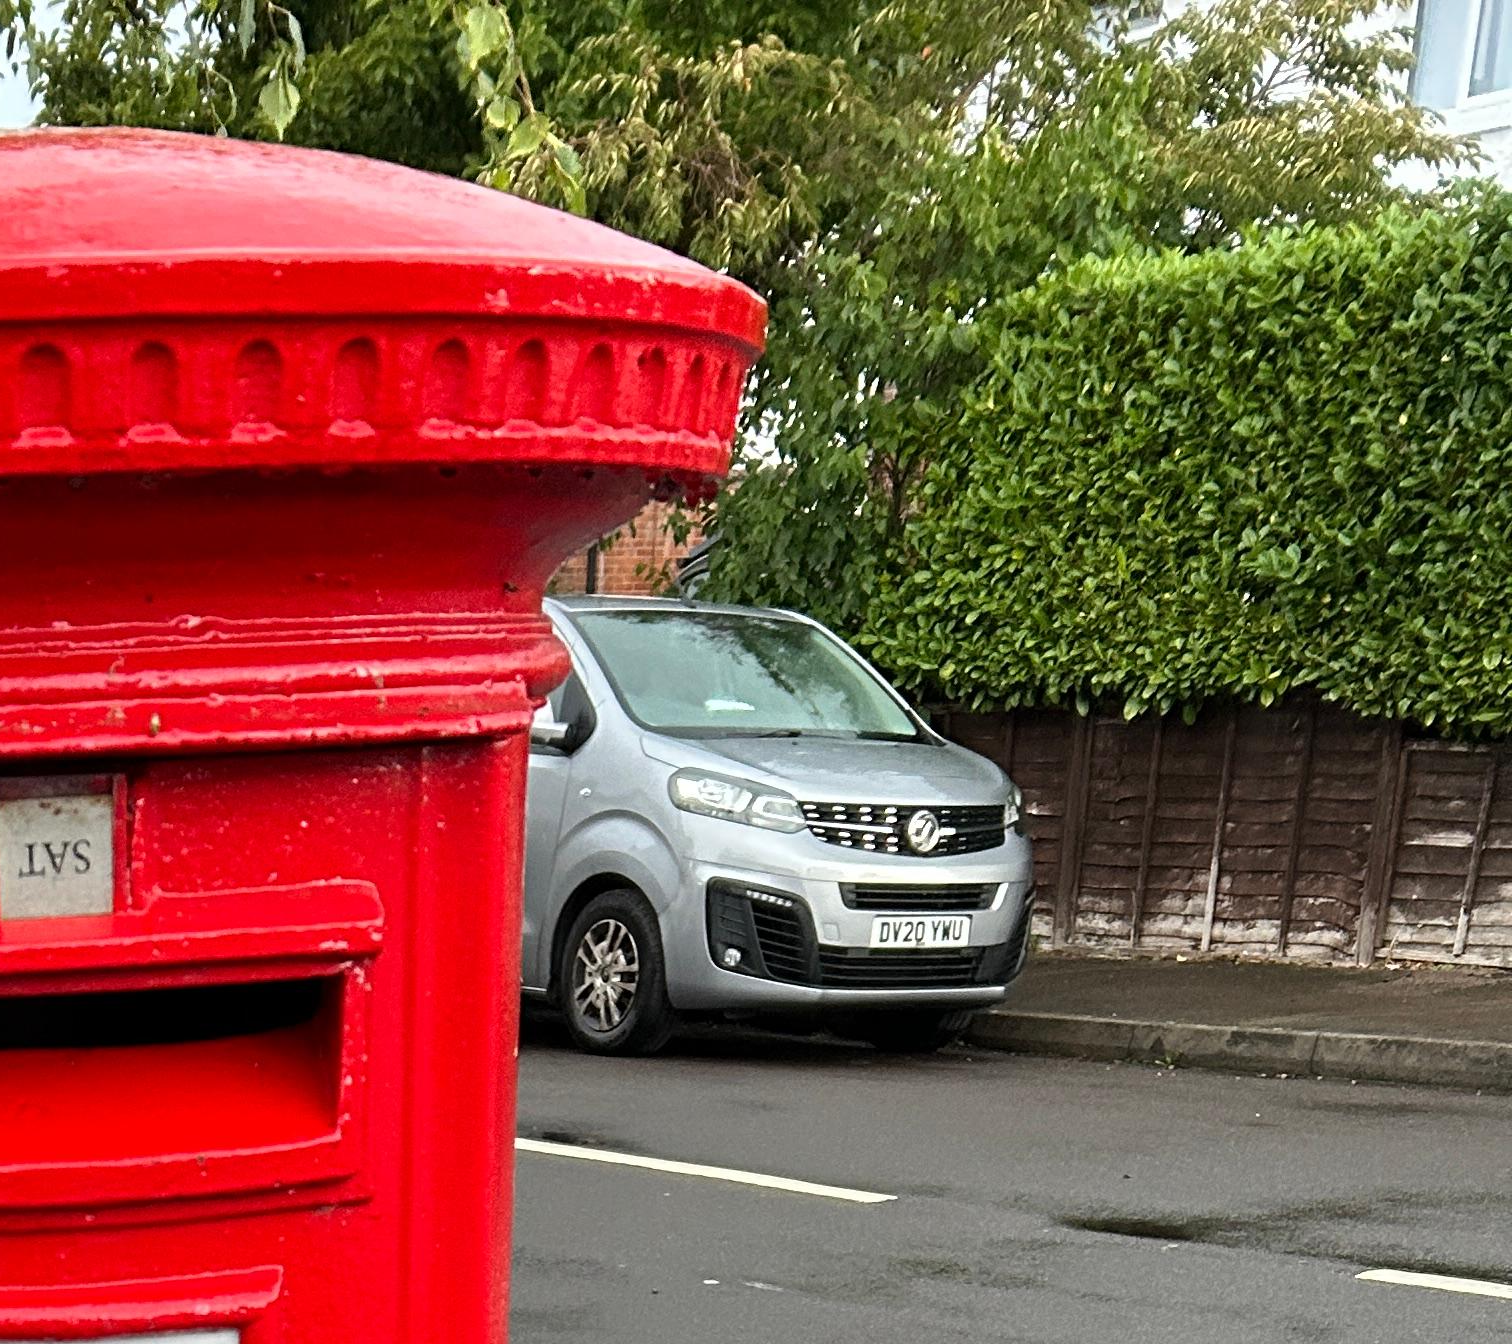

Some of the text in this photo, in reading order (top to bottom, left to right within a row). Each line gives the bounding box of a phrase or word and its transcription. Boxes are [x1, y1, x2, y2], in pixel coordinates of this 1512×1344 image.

[18, 838, 91, 878] SAT
[879, 919, 964, 943] DV20 YWU
